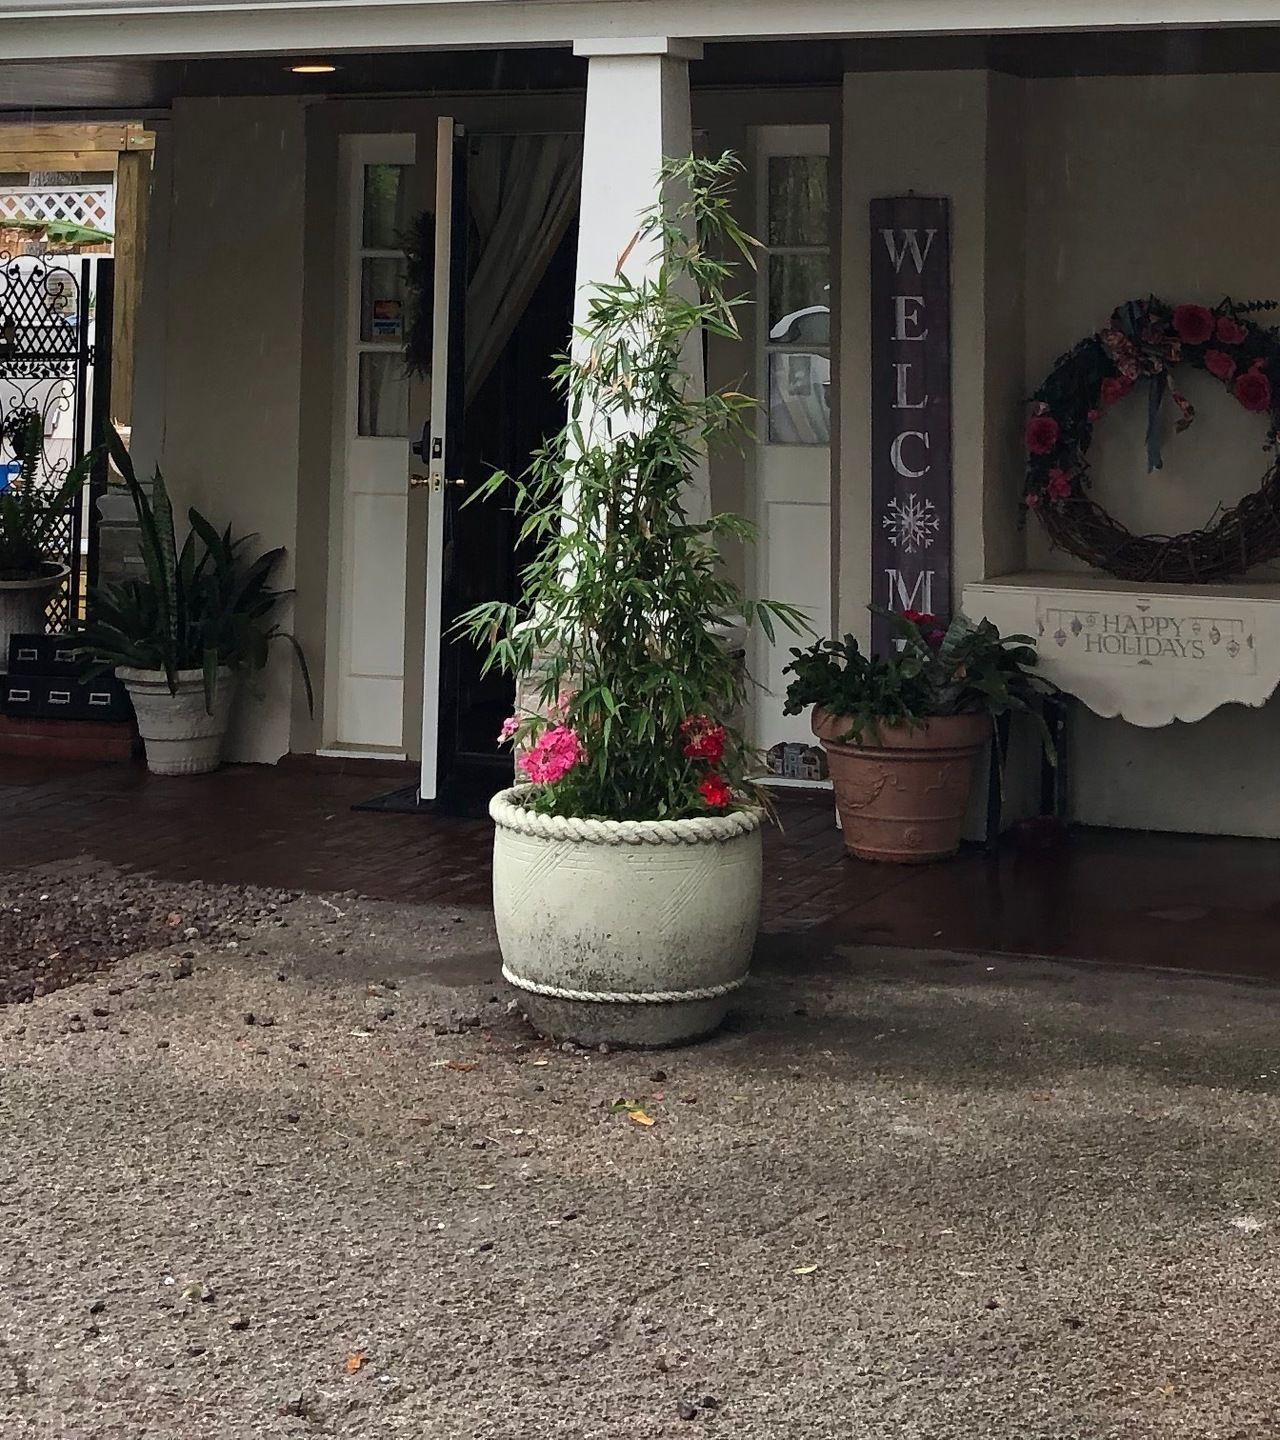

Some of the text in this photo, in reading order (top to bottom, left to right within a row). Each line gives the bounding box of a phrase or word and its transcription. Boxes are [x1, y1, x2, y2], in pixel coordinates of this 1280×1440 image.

[879, 228, 939, 653] WELCM
[1102, 613, 1186, 637] HAPPY
[1084, 633, 1206, 659] HOLIDAYS
